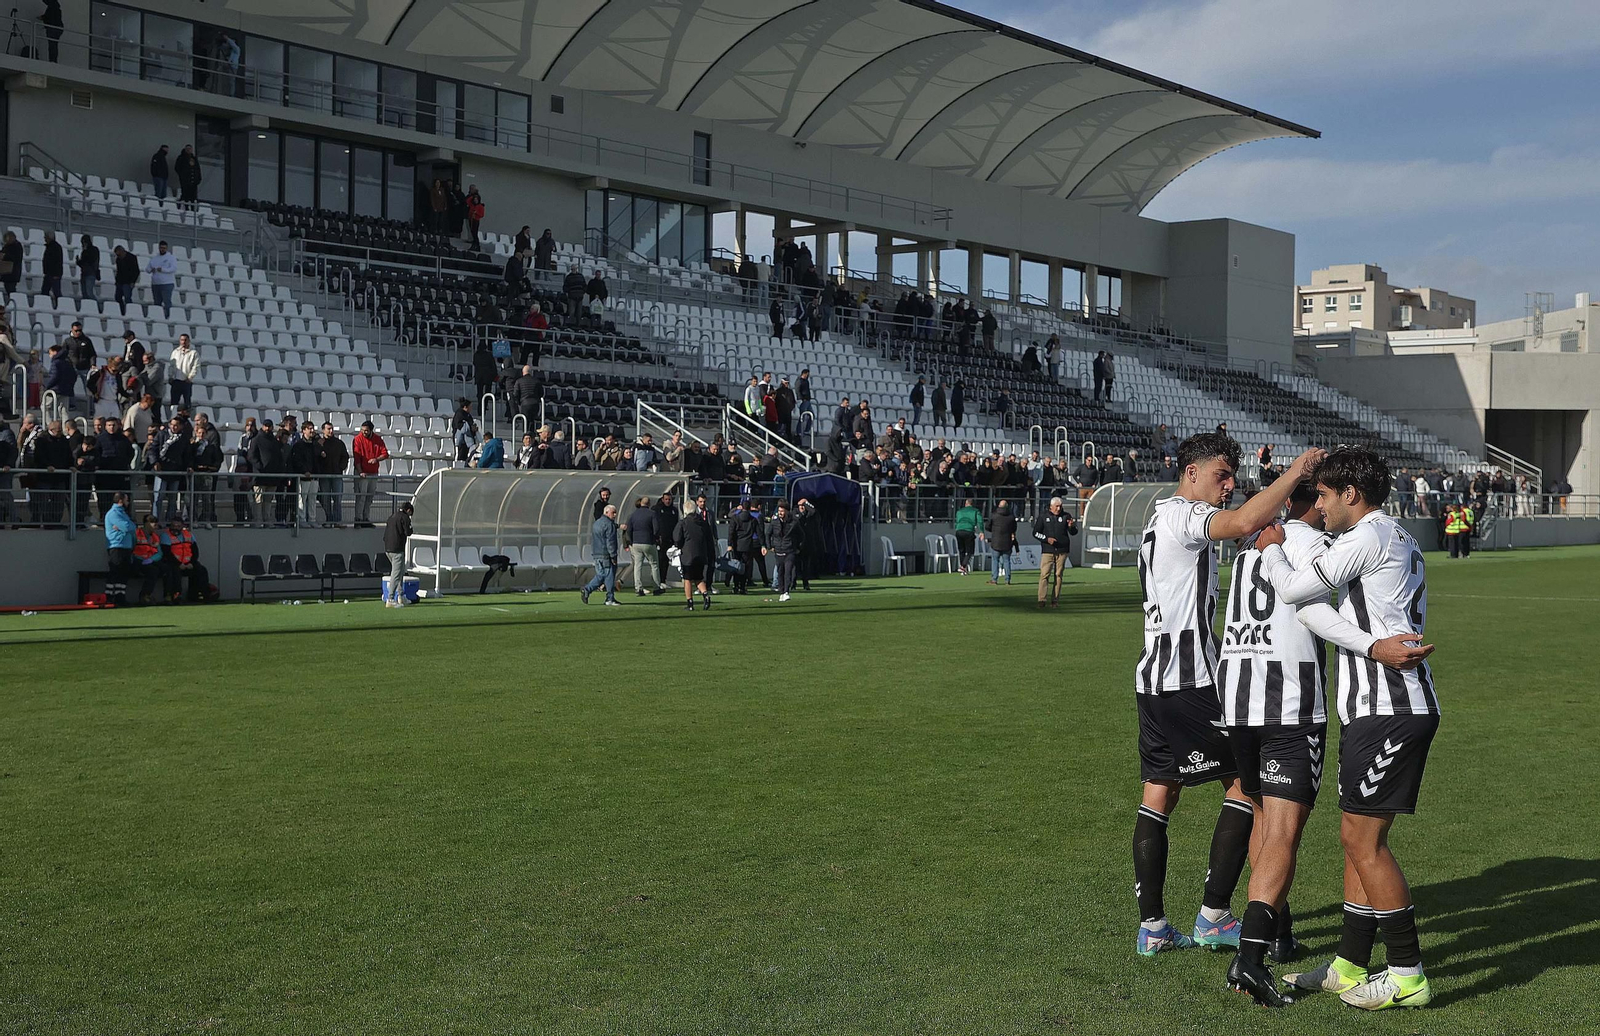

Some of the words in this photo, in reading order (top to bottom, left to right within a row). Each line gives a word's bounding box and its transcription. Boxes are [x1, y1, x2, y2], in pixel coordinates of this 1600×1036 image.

[1232, 552, 1276, 622] 18
[1178, 765, 1195, 774] Ruiz
[1195, 760, 1221, 770] Galán
[1267, 772, 1292, 785] Galán
